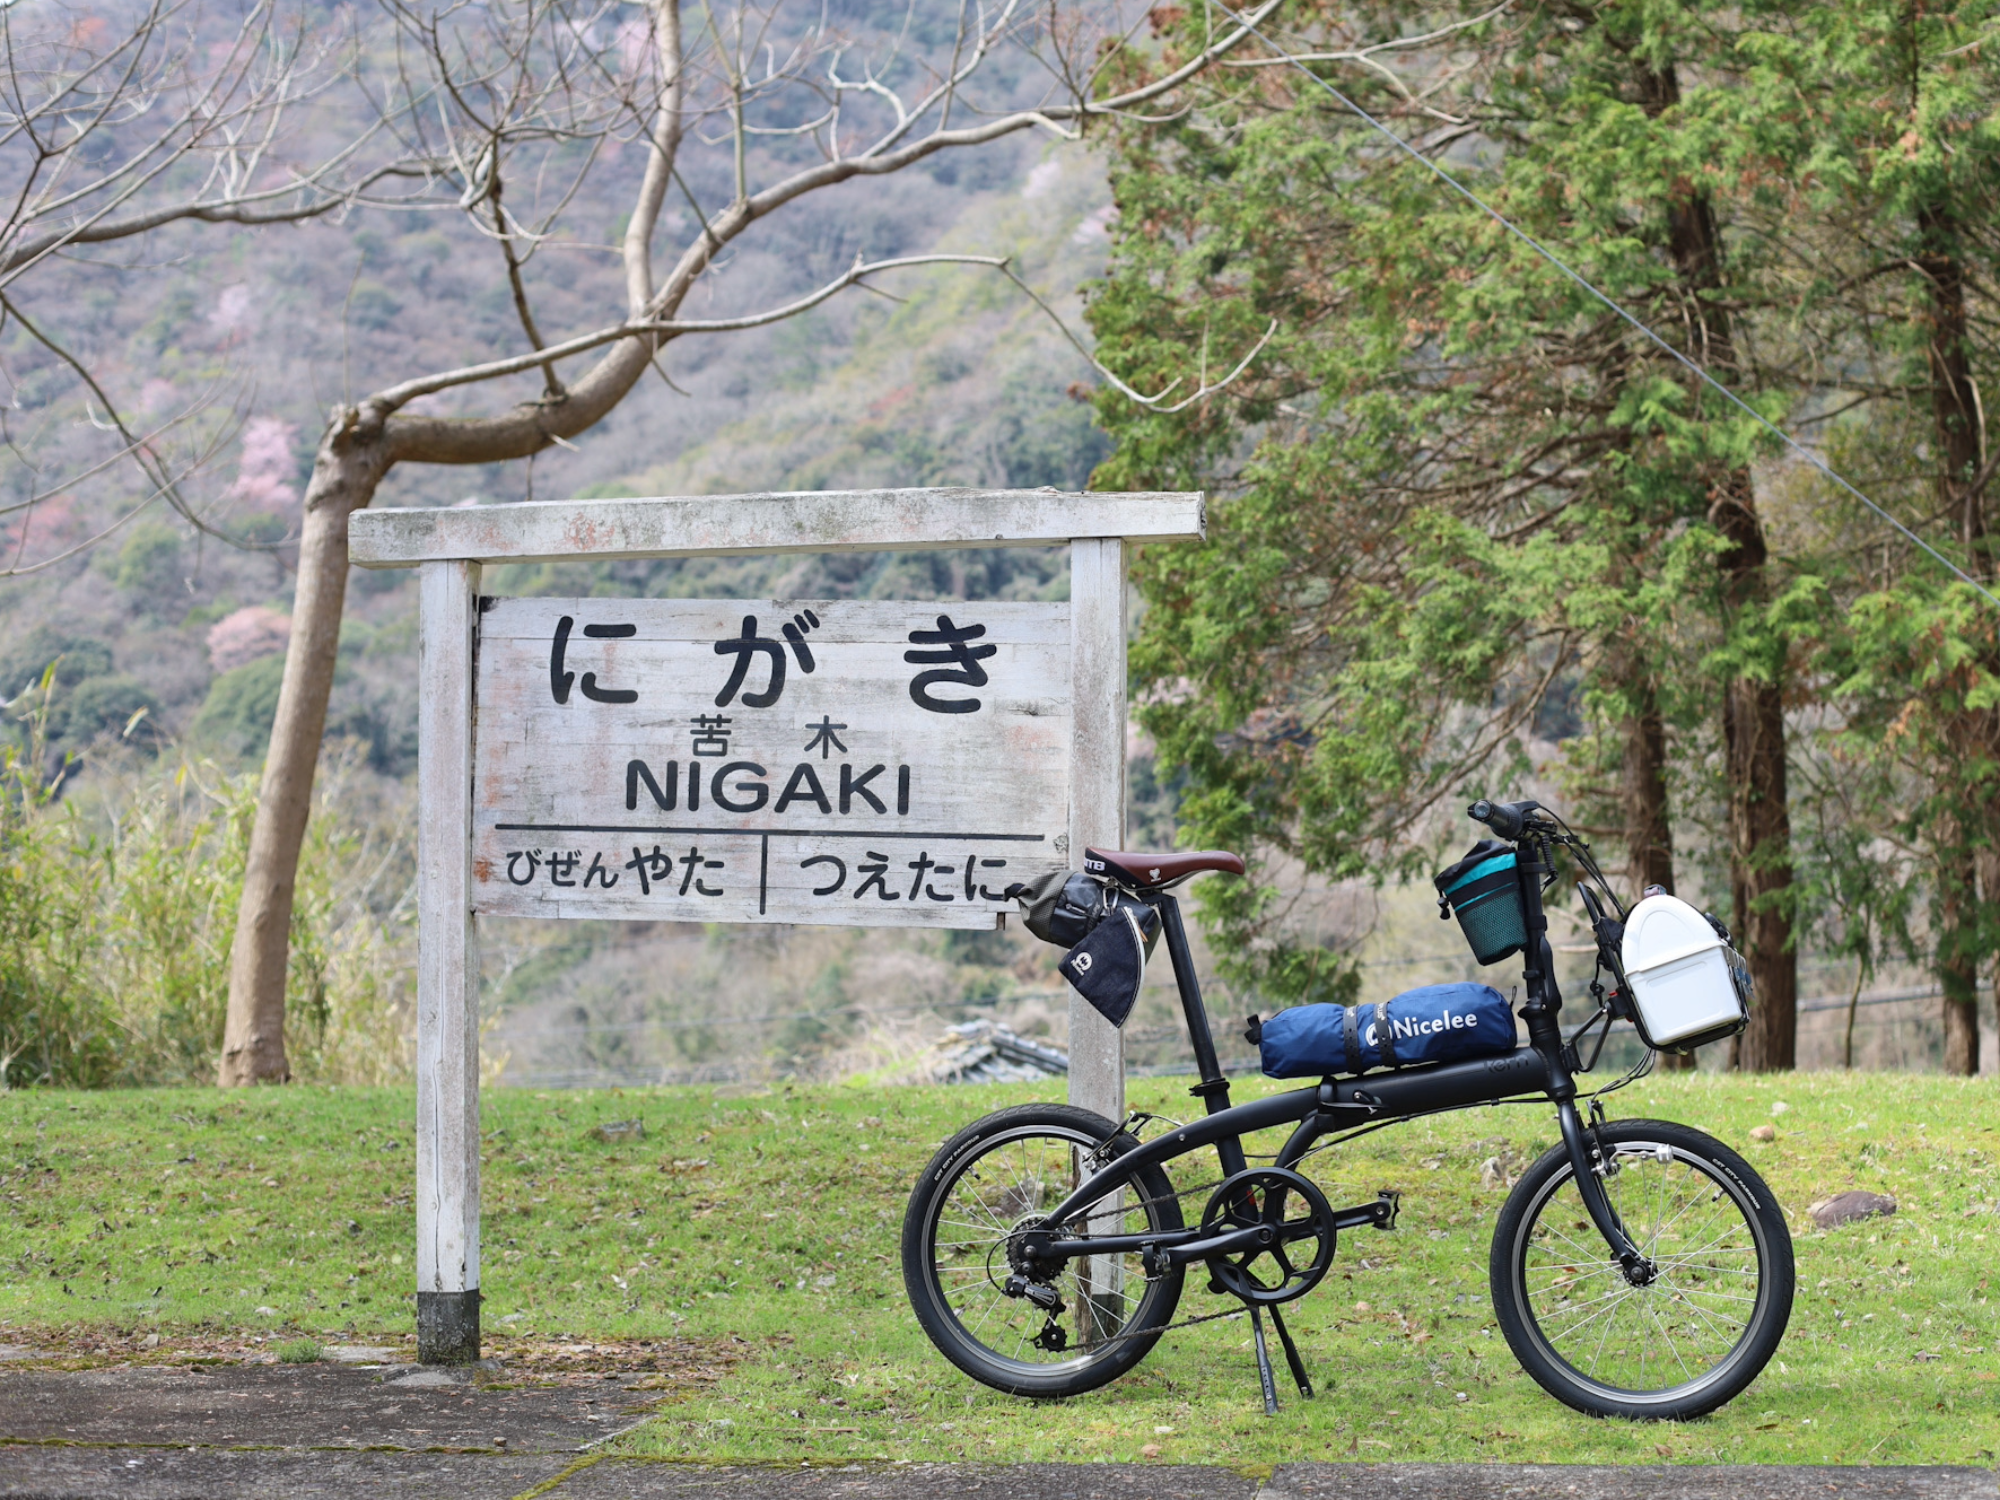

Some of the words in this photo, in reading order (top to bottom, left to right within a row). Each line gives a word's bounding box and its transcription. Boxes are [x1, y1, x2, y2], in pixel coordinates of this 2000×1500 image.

[551, 609, 997, 714] にがき
[691, 714, 848, 760] 苦木
[626, 760, 912, 816] NIGAKI
[506, 846, 725, 897] びぜんやた
[800, 851, 1007, 902] つえたに
[1393, 1009, 1478, 1039] Nicelee
[1484, 1054, 1529, 1073] tern
